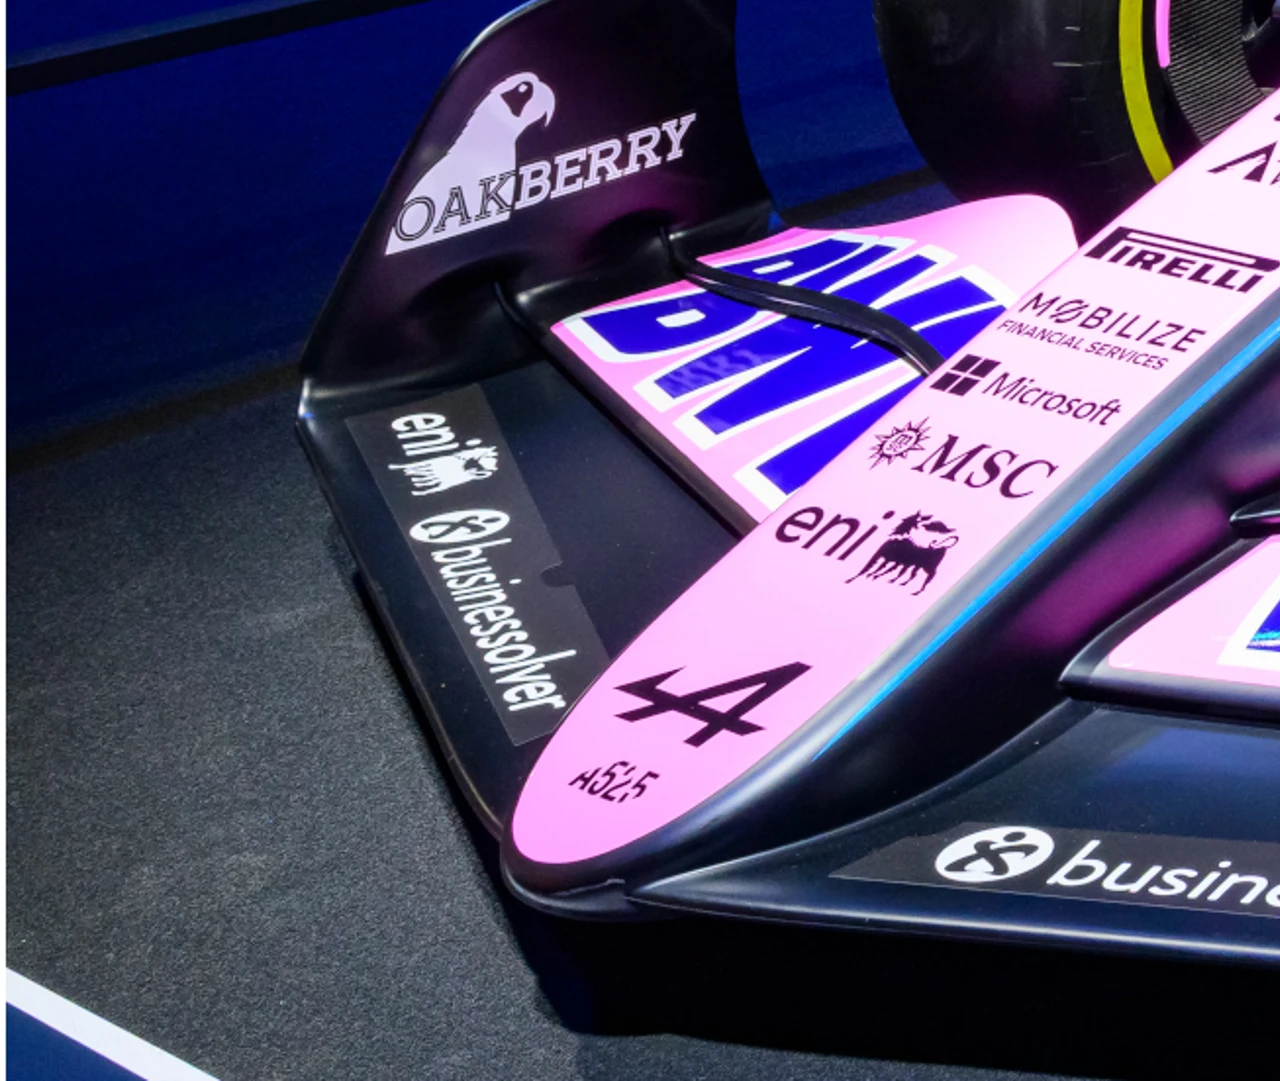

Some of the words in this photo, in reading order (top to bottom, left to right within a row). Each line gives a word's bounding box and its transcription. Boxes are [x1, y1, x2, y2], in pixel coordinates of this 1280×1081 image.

[395, 112, 697, 242] OAKBERRY
[998, 319, 1085, 351] FINANCIAL
[1085, 341, 1169, 371] SERVICES
[982, 372, 1123, 426] Microsoft
[391, 412, 482, 457] eni
[911, 434, 1059, 499] MSC
[775, 506, 895, 561] eni
[430, 537, 577, 713] businessolver
